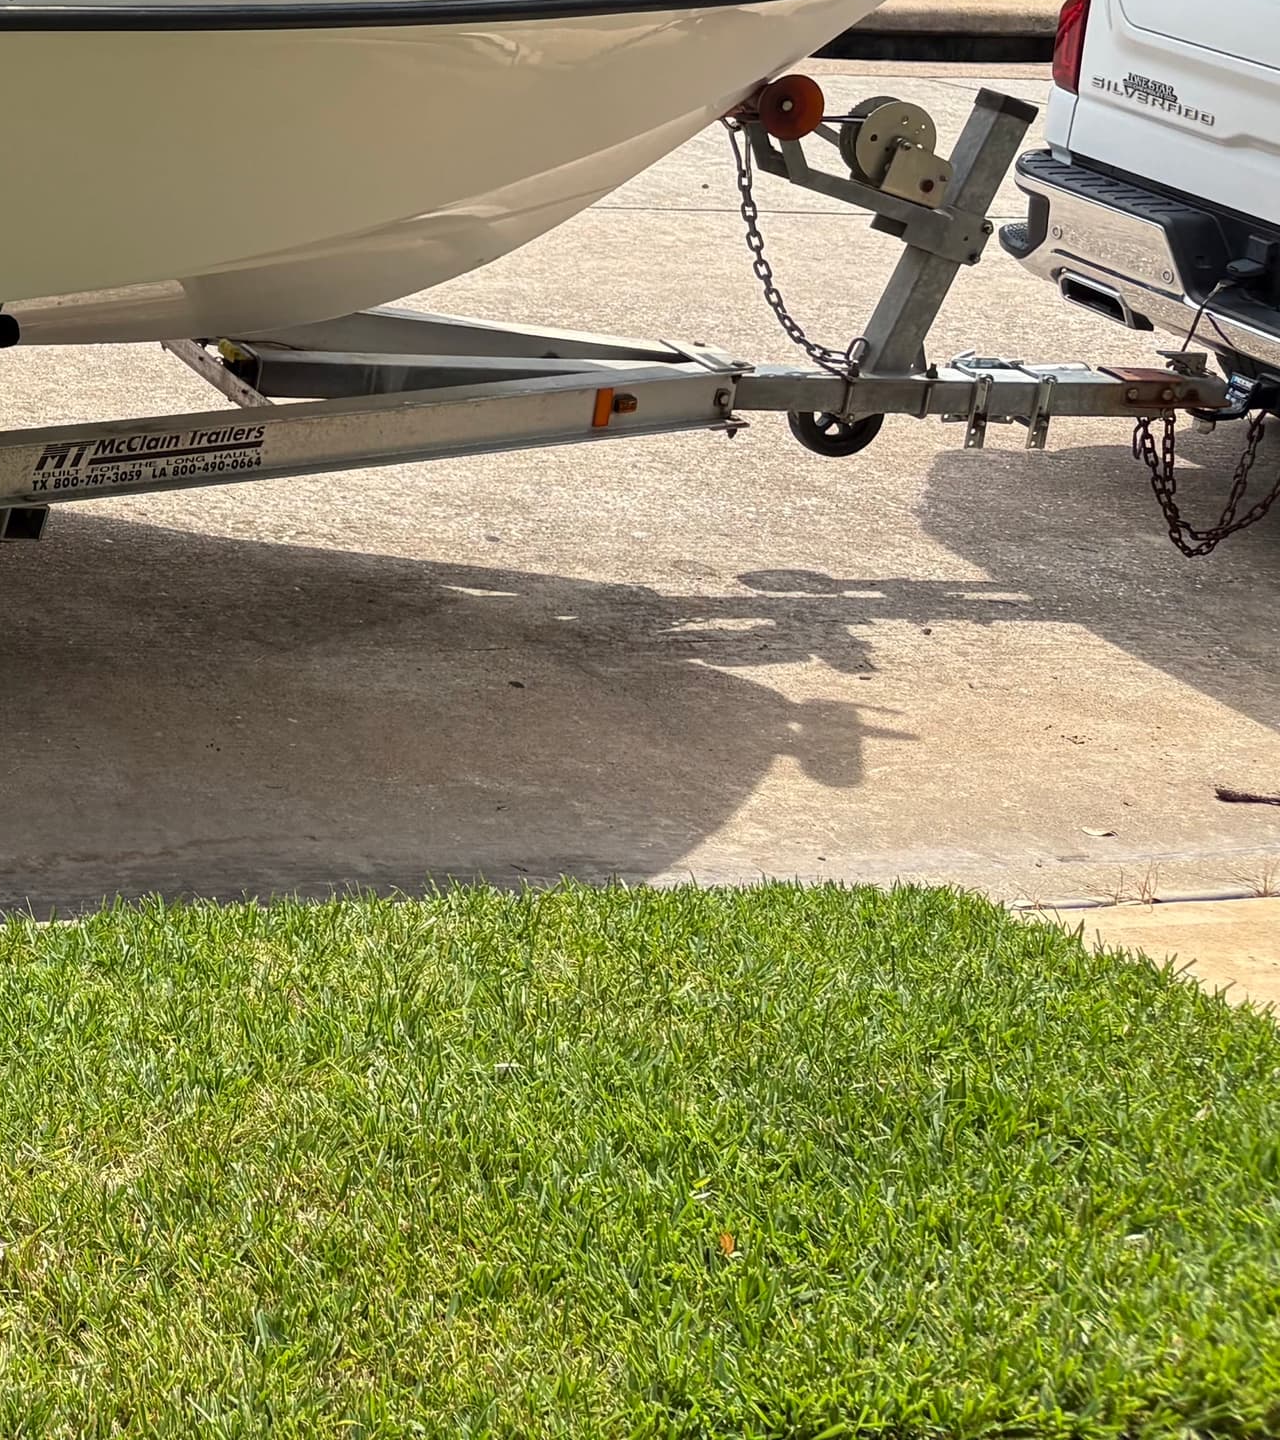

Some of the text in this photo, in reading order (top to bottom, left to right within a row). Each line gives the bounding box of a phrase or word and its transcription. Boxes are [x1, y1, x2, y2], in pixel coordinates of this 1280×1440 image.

[1091, 76, 1216, 126] SILVERADO
[1149, 79, 1175, 96] STAR
[93, 426, 266, 456] McClain Trailers
[32, 480, 48, 491] TX
[152, 467, 167, 479] LA
[172, 457, 262, 476] 800-490-0664
[91, 464, 120, 474] FOR
[166, 455, 205, 466] LONG
